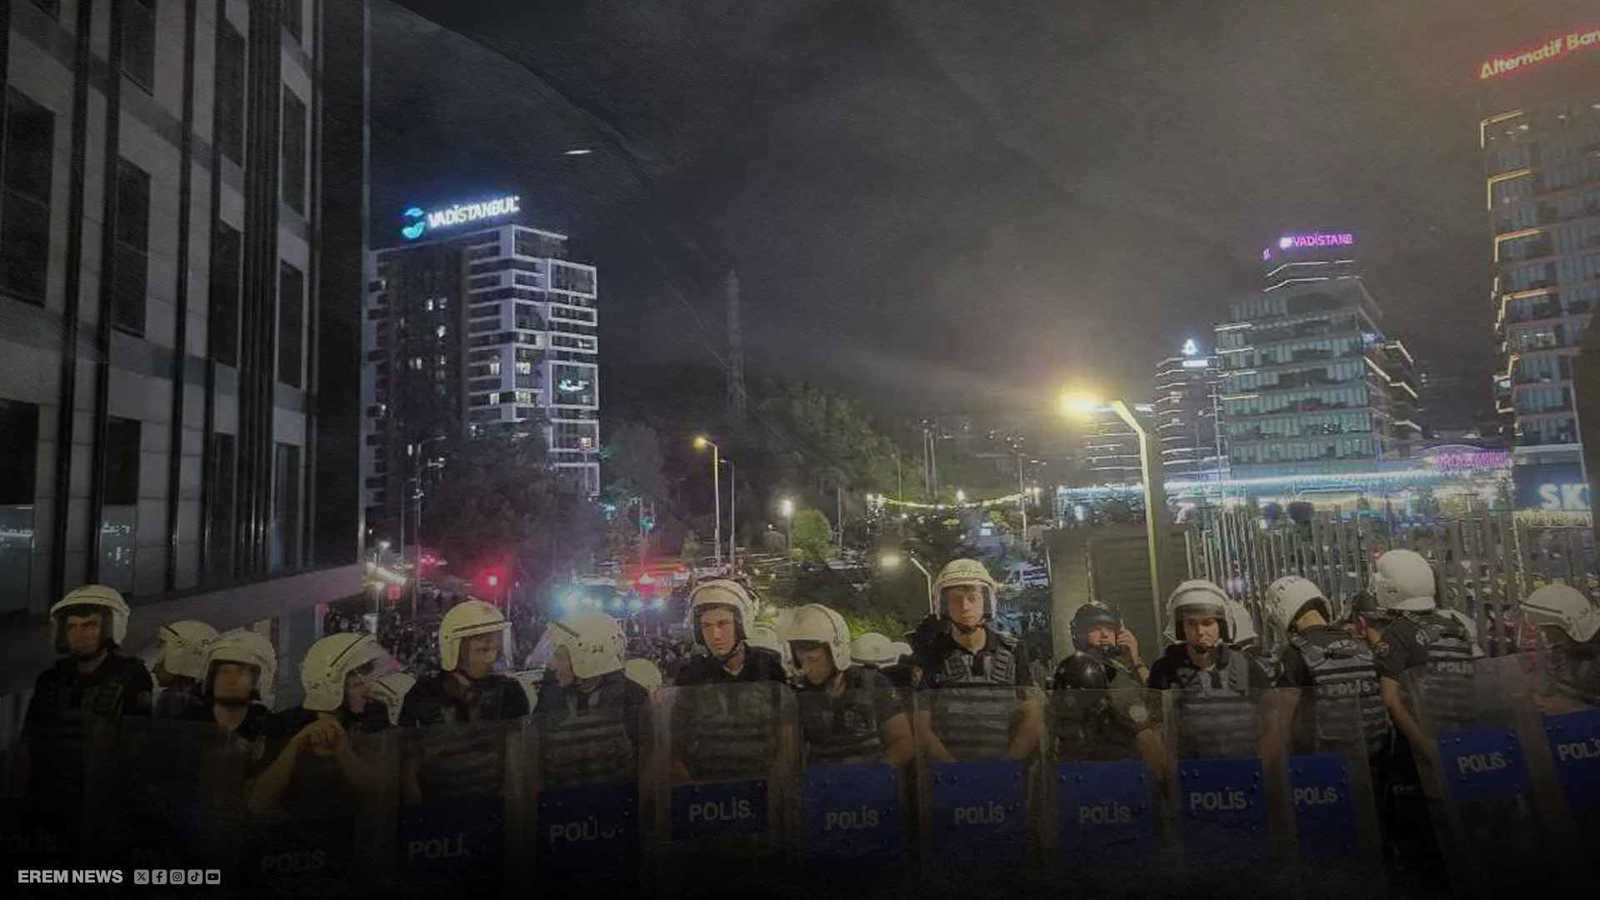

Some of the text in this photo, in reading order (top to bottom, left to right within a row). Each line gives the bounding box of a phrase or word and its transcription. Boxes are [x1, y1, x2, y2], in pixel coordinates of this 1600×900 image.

[1480, 37, 1563, 79] Alternatif
[687, 796, 753, 823] POLİS
[1189, 786, 1248, 813] POLİS
